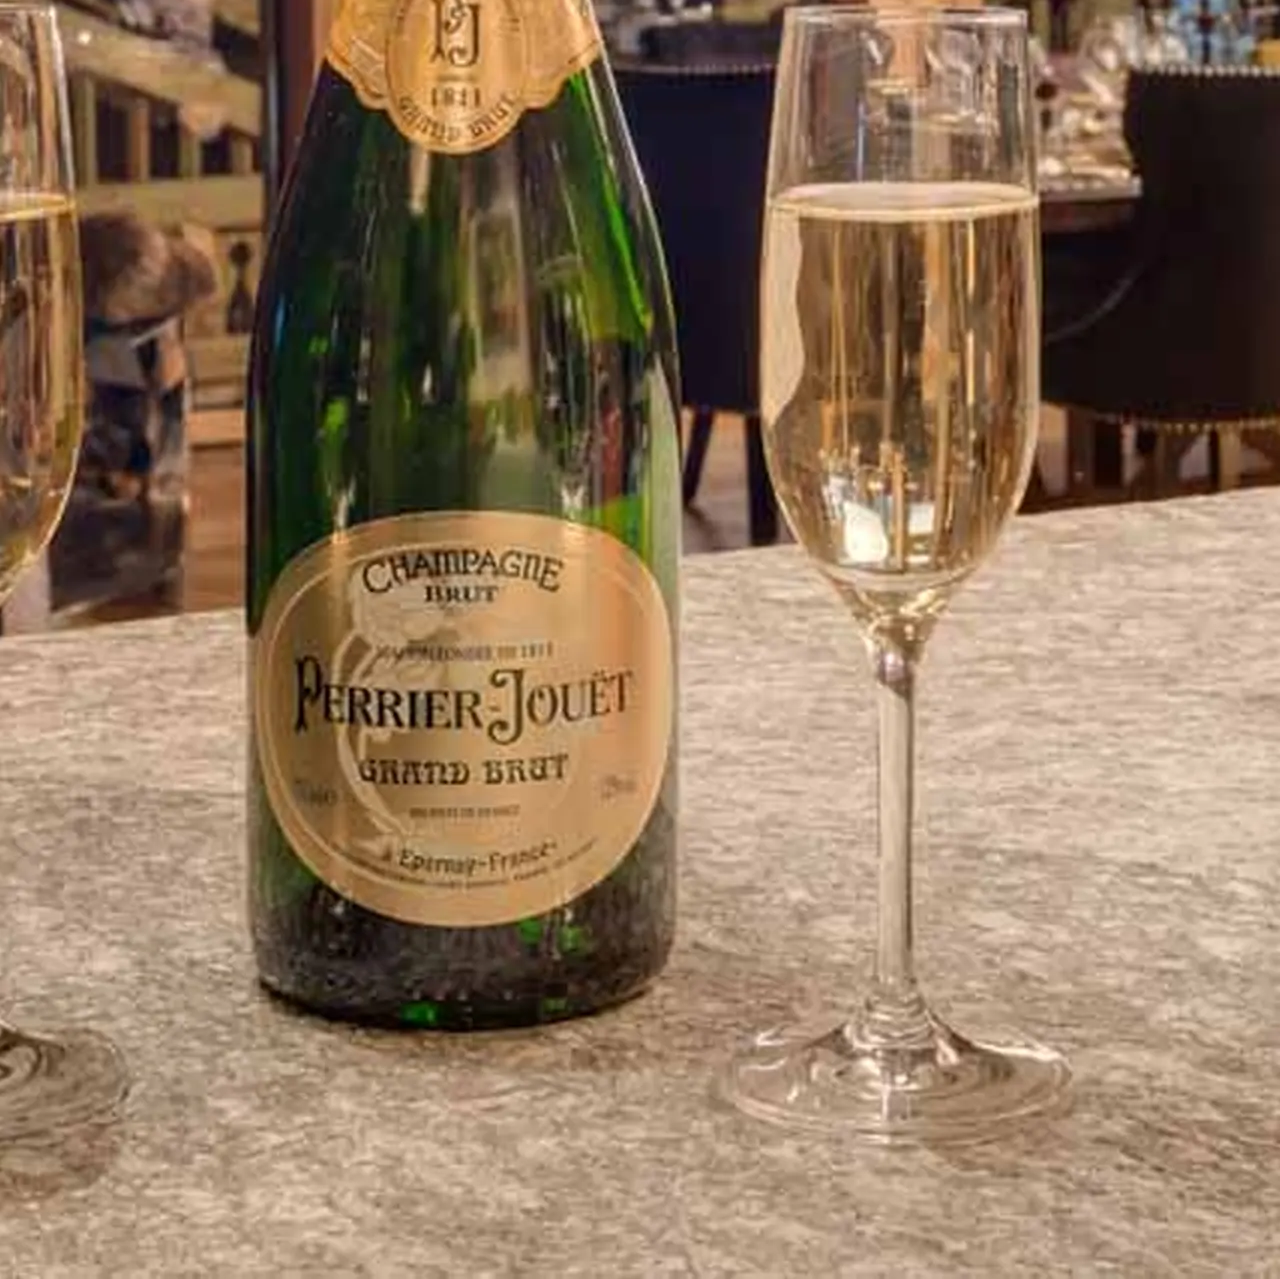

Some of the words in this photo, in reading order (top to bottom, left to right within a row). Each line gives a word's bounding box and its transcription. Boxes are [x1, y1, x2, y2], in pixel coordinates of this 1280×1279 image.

[362, 548, 564, 594] CHAMPAGNE
[424, 584, 499, 604] BRUT
[358, 758, 470, 785] GRAND
[482, 753, 569, 785] BRUT
